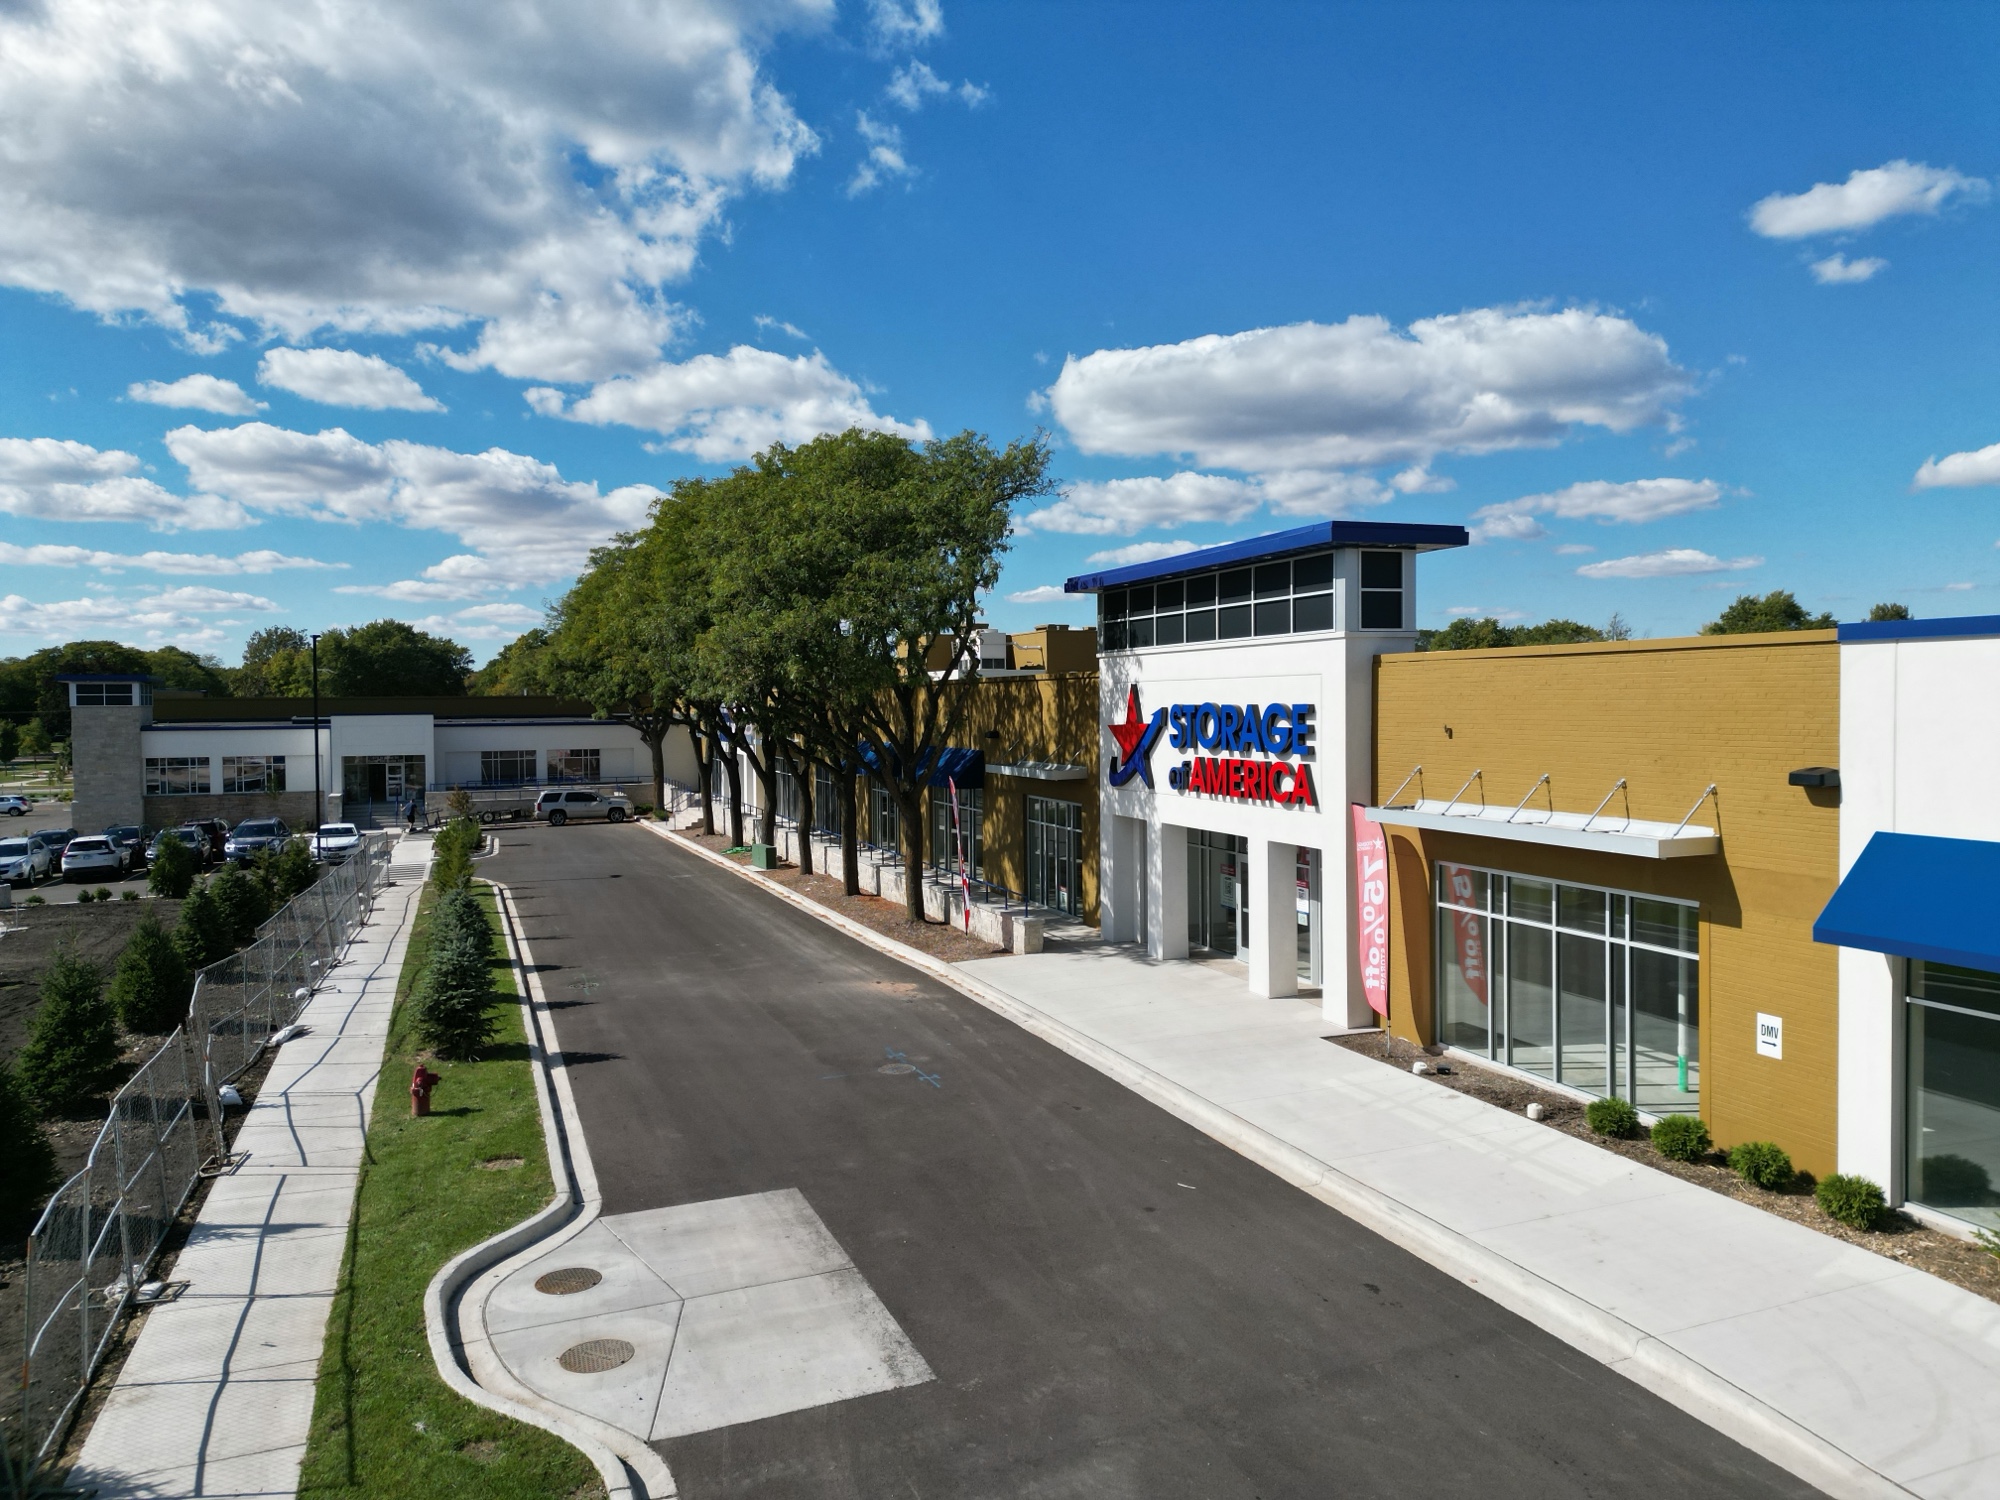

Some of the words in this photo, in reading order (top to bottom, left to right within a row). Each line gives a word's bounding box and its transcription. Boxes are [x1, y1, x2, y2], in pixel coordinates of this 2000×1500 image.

[1169, 702, 1314, 756] STORAGE
[1169, 761, 1191, 789] of
[1189, 757, 1314, 807] AMERICA
[1761, 1024, 1779, 1039] DMV
